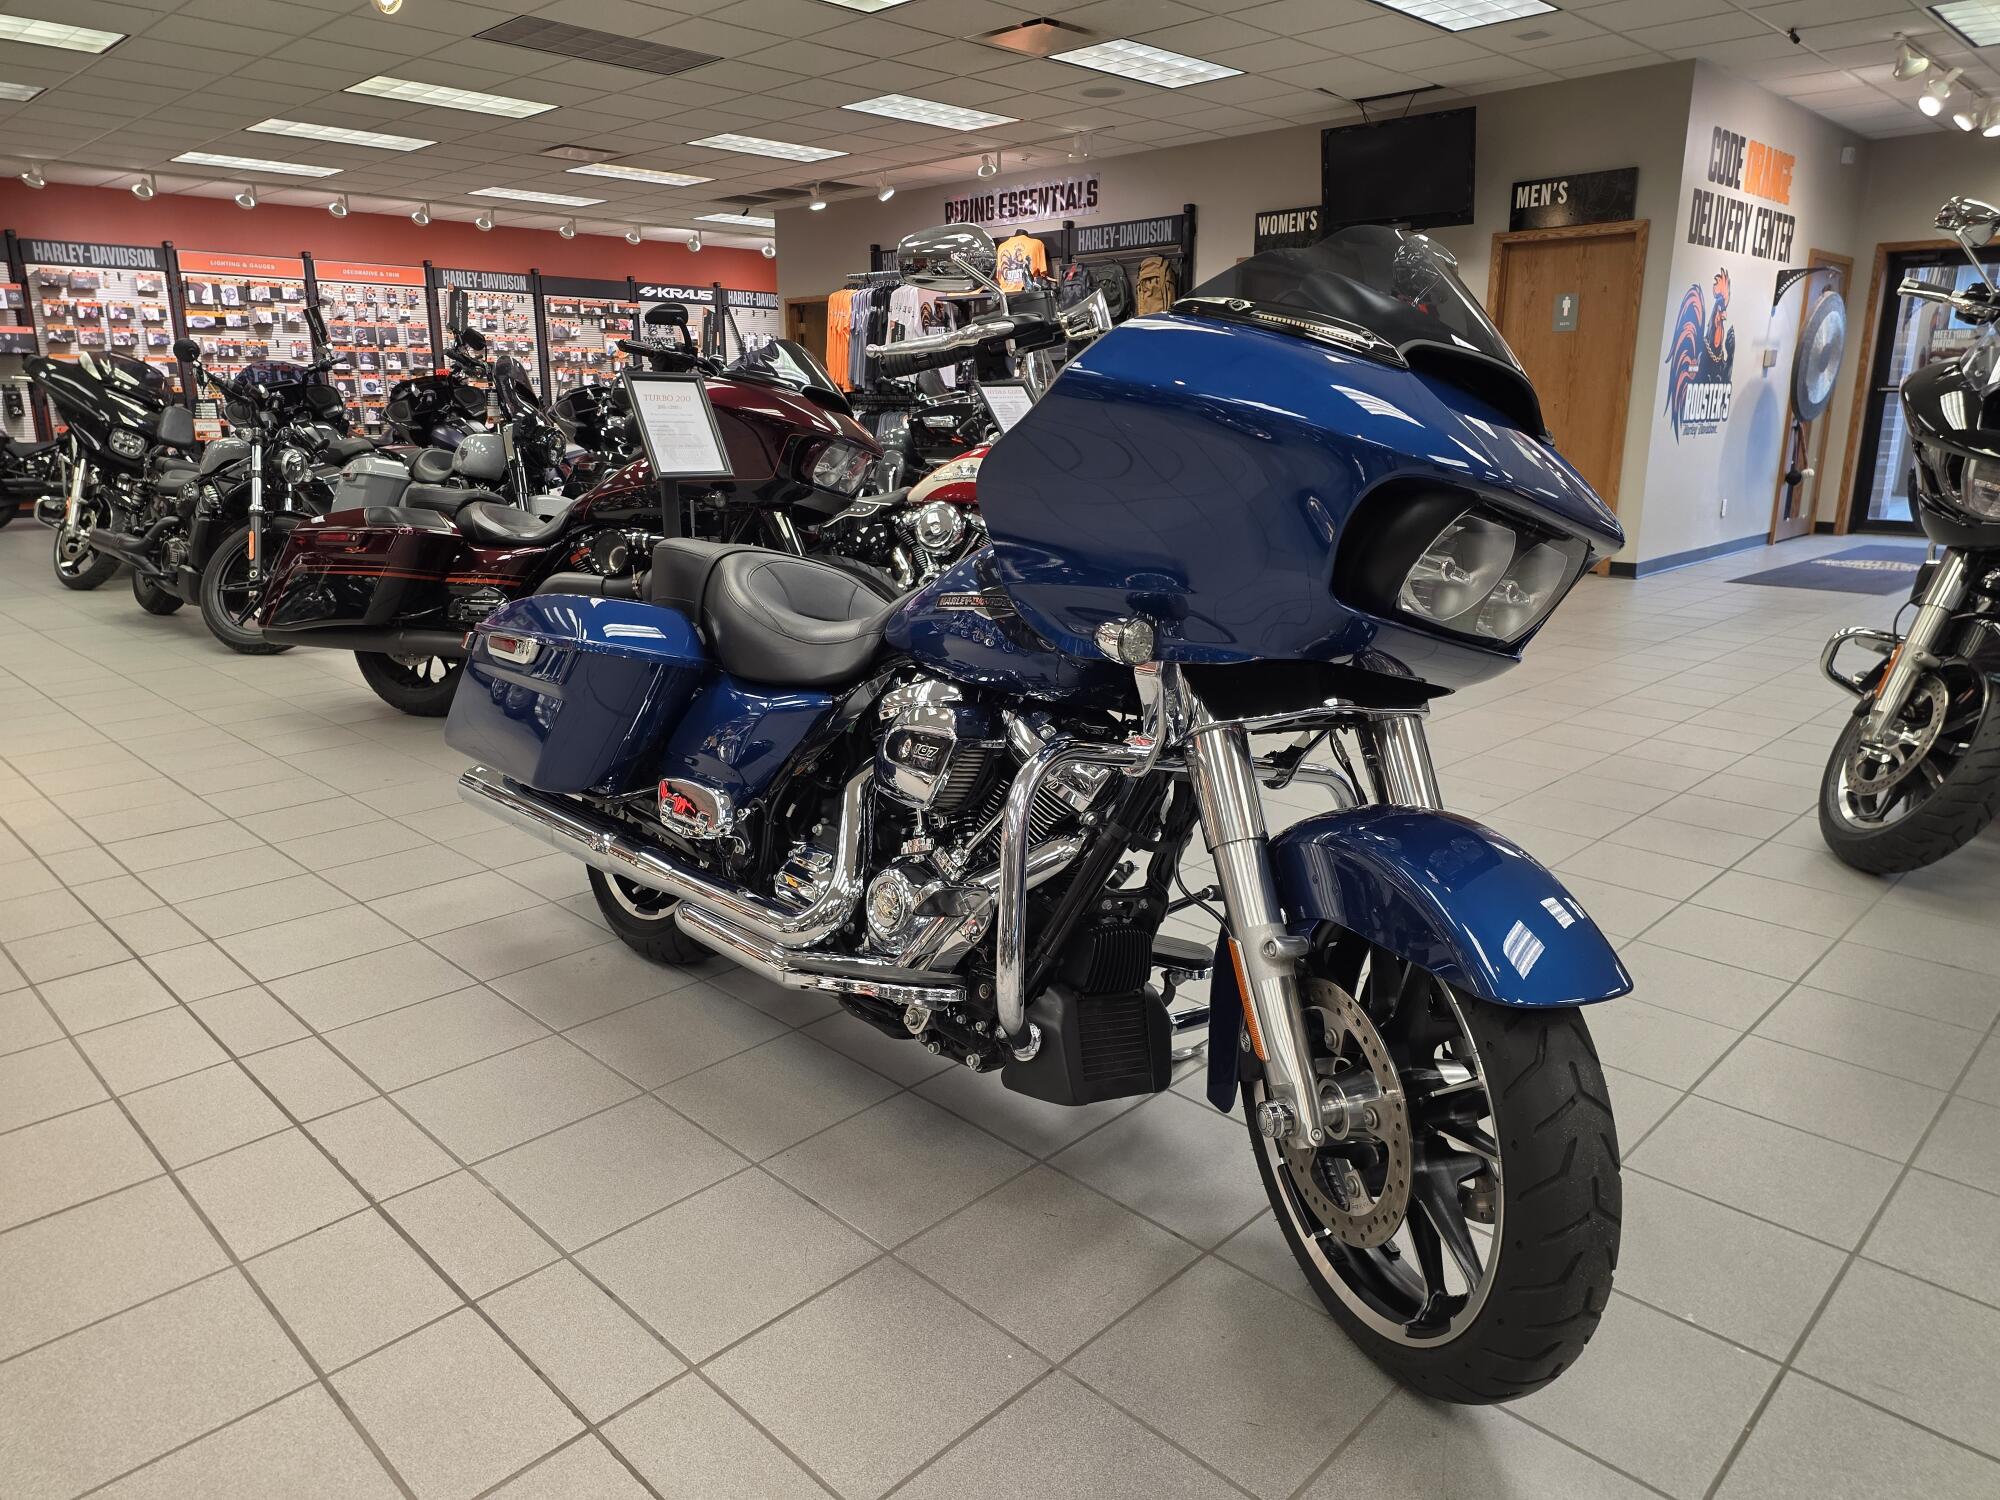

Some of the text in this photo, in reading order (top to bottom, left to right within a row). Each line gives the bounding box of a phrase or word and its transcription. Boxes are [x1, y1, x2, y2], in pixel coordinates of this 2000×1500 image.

[1708, 126, 1796, 206] CODE ORANGE
[945, 179, 1098, 225] RIDING ESSENTIALS
[1516, 181, 1568, 209] MEN'S
[1078, 219, 1172, 251] HARLEY-DAVIDSON
[1258, 211, 1318, 236] WOMEN'S
[1688, 188, 1796, 263] DELIVERY CENTER
[32, 241, 156, 268] HARLEY-DAVIDSON
[210, 259, 241, 268] LIGHTING
[249, 262, 276, 270] GAUGES
[442, 270, 527, 291] HARLEY-DAVIDSON
[657, 287, 714, 301] KRAUS
[643, 394, 674, 402] TURBO
[1684, 382, 1731, 421] ROOSTER'S
[914, 743, 939, 758] 107
